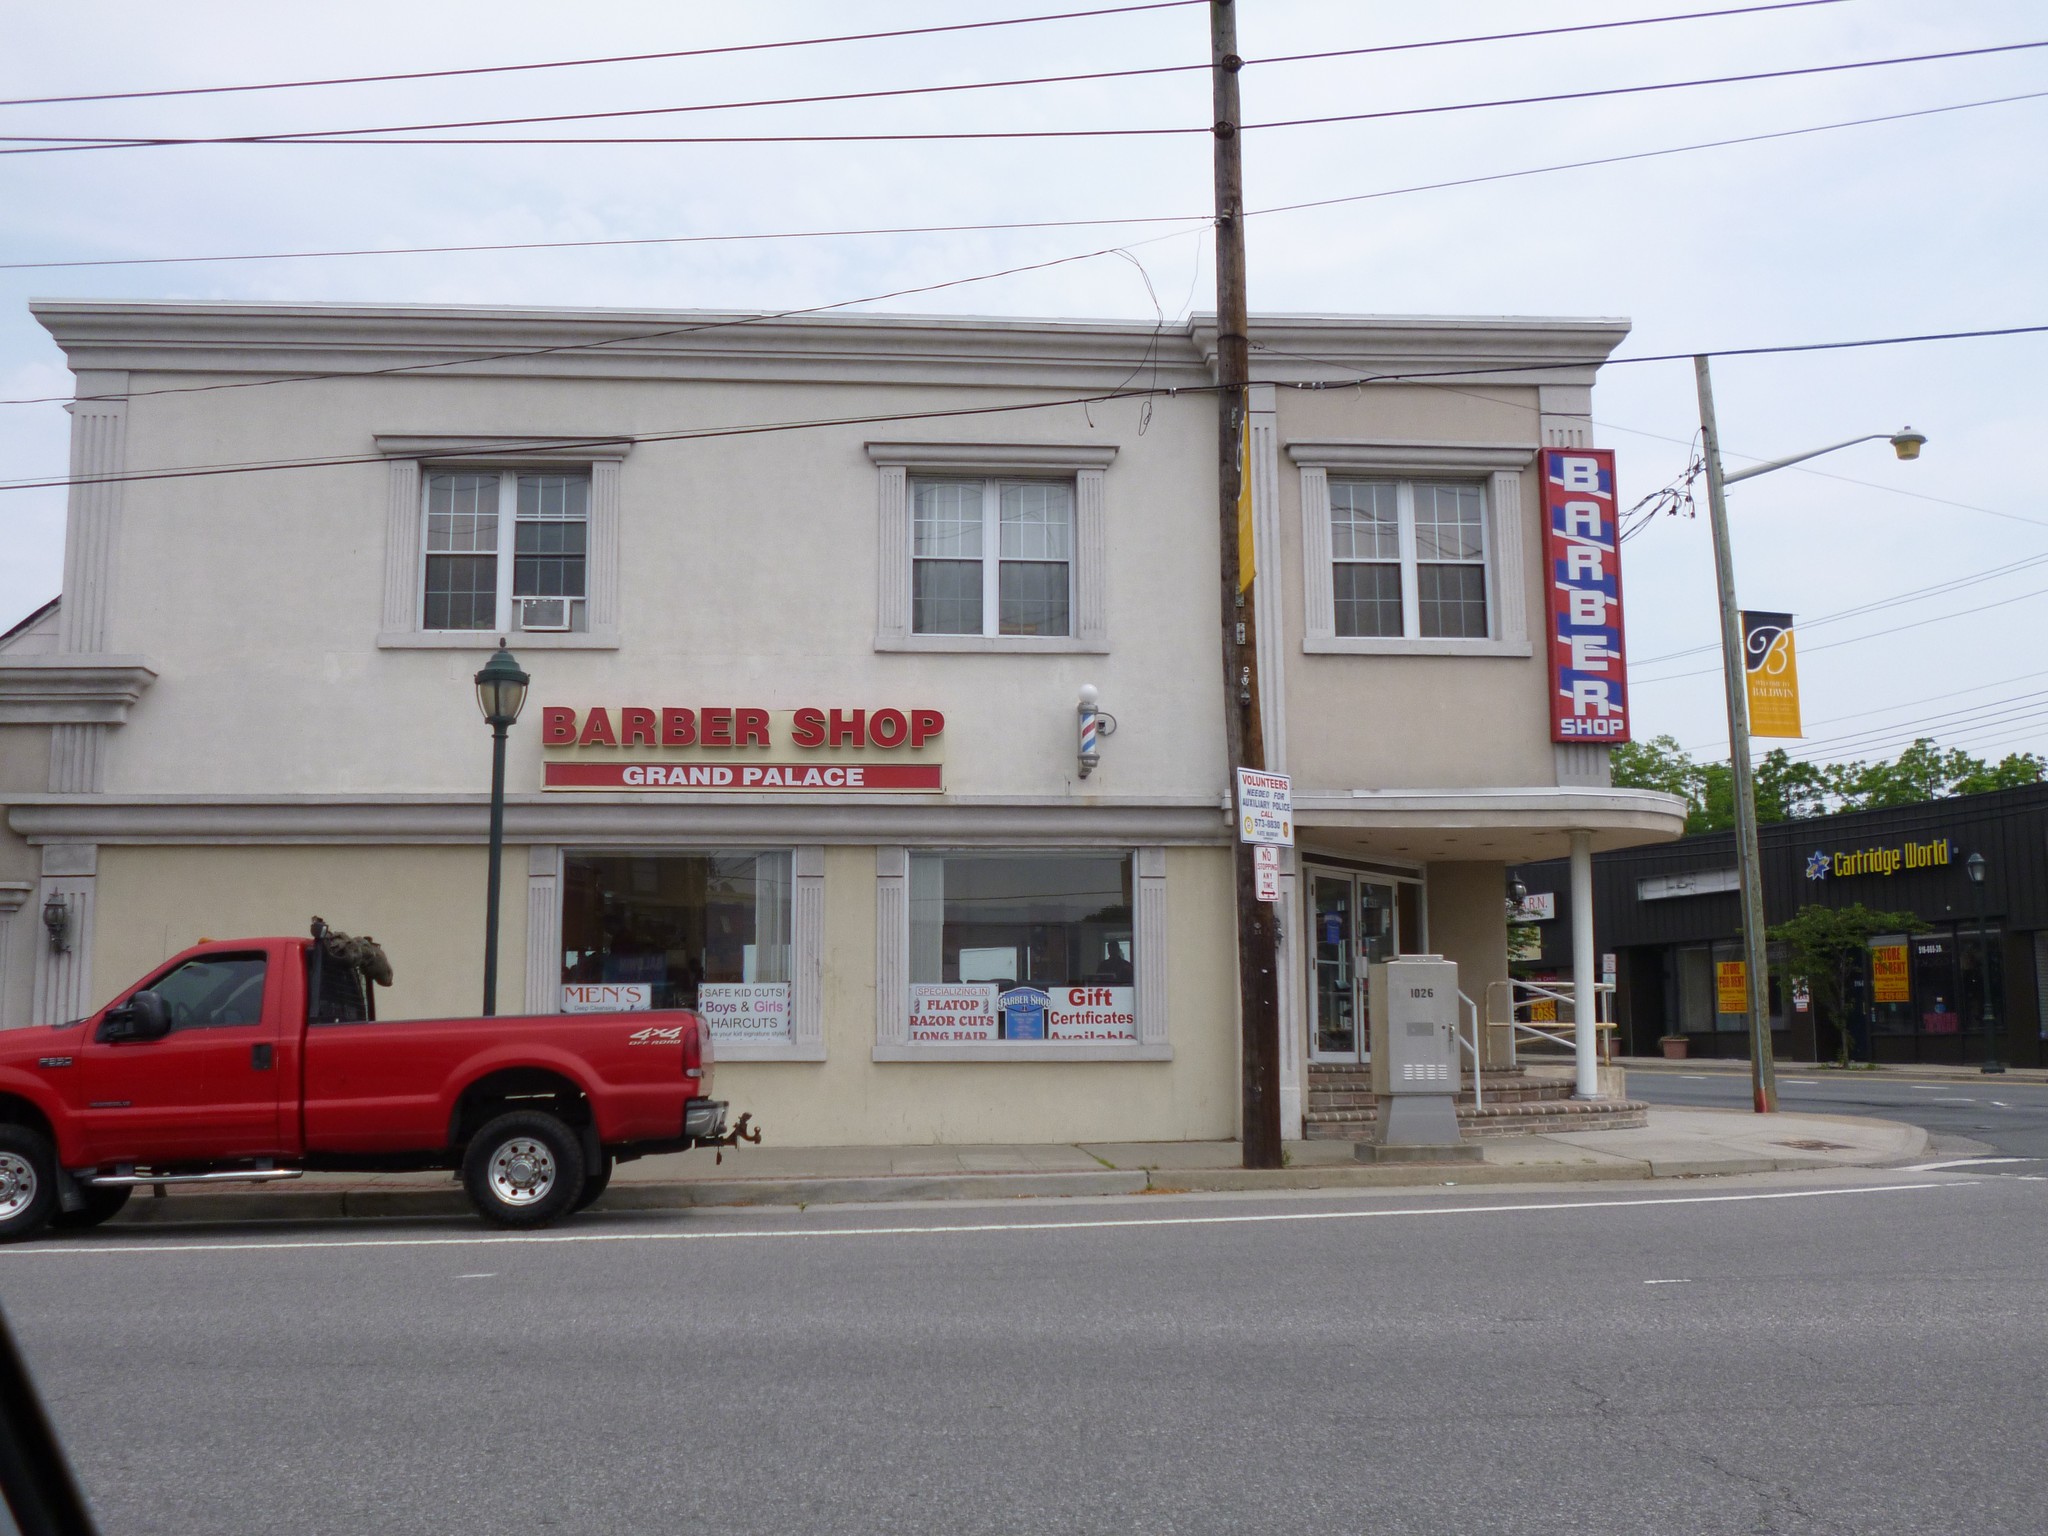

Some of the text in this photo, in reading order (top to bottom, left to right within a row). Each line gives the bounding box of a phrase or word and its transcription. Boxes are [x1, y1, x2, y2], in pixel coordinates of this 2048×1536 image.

[1562, 456, 1609, 716] BARBER
[1752, 687, 1794, 698] BALDWIN
[542, 706, 946, 749] BARBER SHOP
[1560, 719, 1625, 736] SHOP
[622, 766, 865, 787] GRAND PALACE
[1242, 774, 1288, 790] VOLUNTEERS
[1246, 788, 1285, 801] NEEDED FOR
[1242, 798, 1291, 812] AUXILIARY POLICE
[1261, 851, 1272, 862] NO
[1834, 838, 1949, 877] Cartridge World
[1257, 863, 1278, 871] STOPPING
[1262, 881, 1274, 889] TIME
[1889, 961, 1906, 975] RENT
[565, 986, 642, 1003] MEN'S
[704, 988, 785, 998] SAFE KID CUTS!
[918, 987, 988, 996] SPECIALIZING IN
[1068, 987, 1113, 1007] Gift
[1410, 988, 1434, 998] 1026
[705, 1000, 784, 1016] Boys & Girls
[927, 999, 980, 1011] FLATOP
[998, 994, 1052, 1010] BARBER SHOP
[909, 1015, 995, 1026] RAZOR CUTS
[1050, 1010, 1134, 1025] Certificates
[1531, 1007, 1556, 1021] LOSS
[711, 1017, 778, 1029] HAIRCUTS
[629, 1025, 683, 1041] 4x4
[912, 1031, 988, 1040] LONG HAIR
